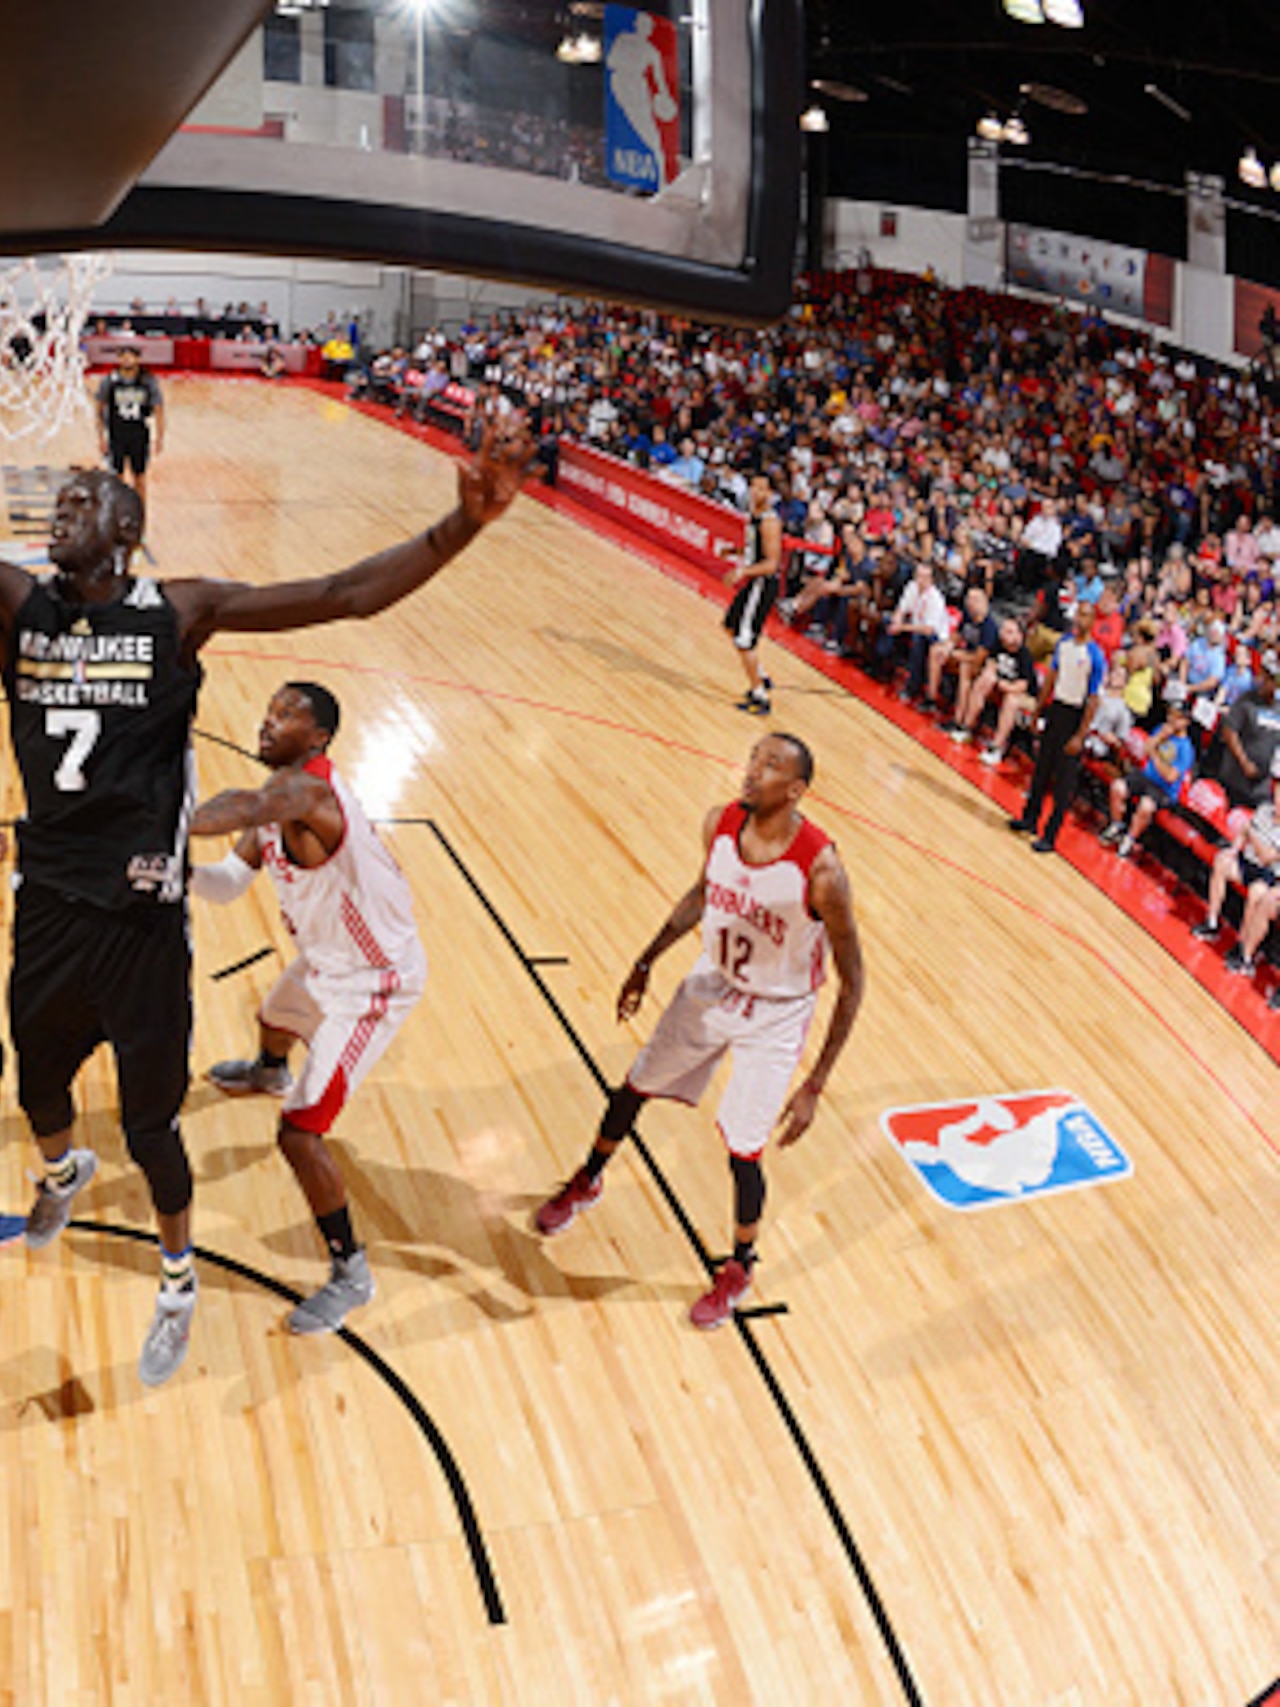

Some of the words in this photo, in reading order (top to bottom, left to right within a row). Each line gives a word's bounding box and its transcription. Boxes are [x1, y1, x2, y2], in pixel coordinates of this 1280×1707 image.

[613, 147, 657, 183] NBA
[45, 708, 102, 792] 7
[717, 926, 754, 983] 12
[1063, 1115, 1121, 1169] NBA
